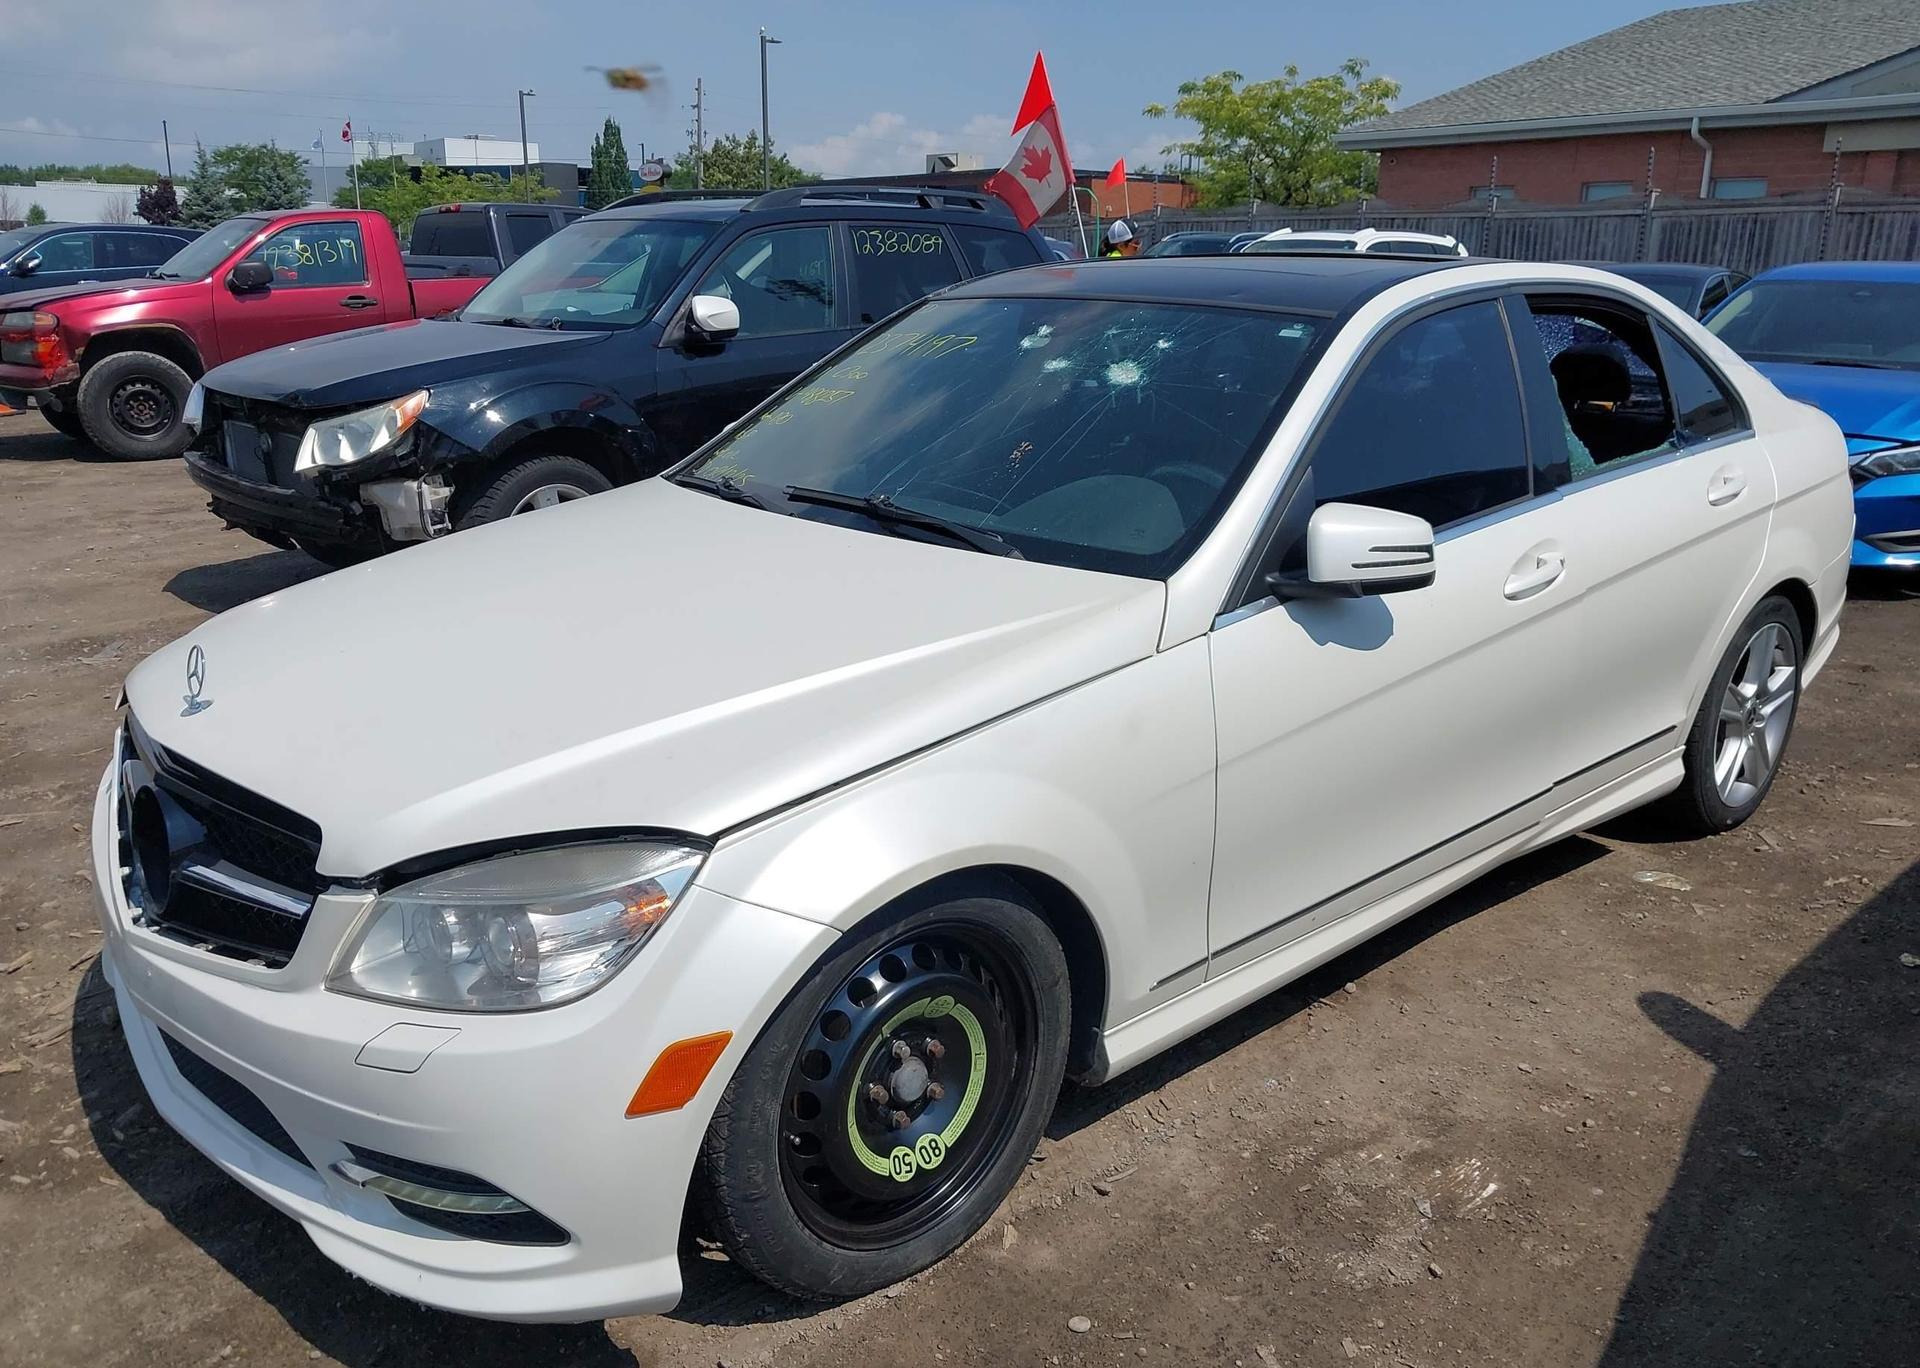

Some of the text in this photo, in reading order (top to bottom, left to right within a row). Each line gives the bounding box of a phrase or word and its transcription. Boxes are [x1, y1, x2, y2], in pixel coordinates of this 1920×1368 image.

[851, 229, 942, 256] 12382089
[892, 1138, 942, 1175] 80 50
